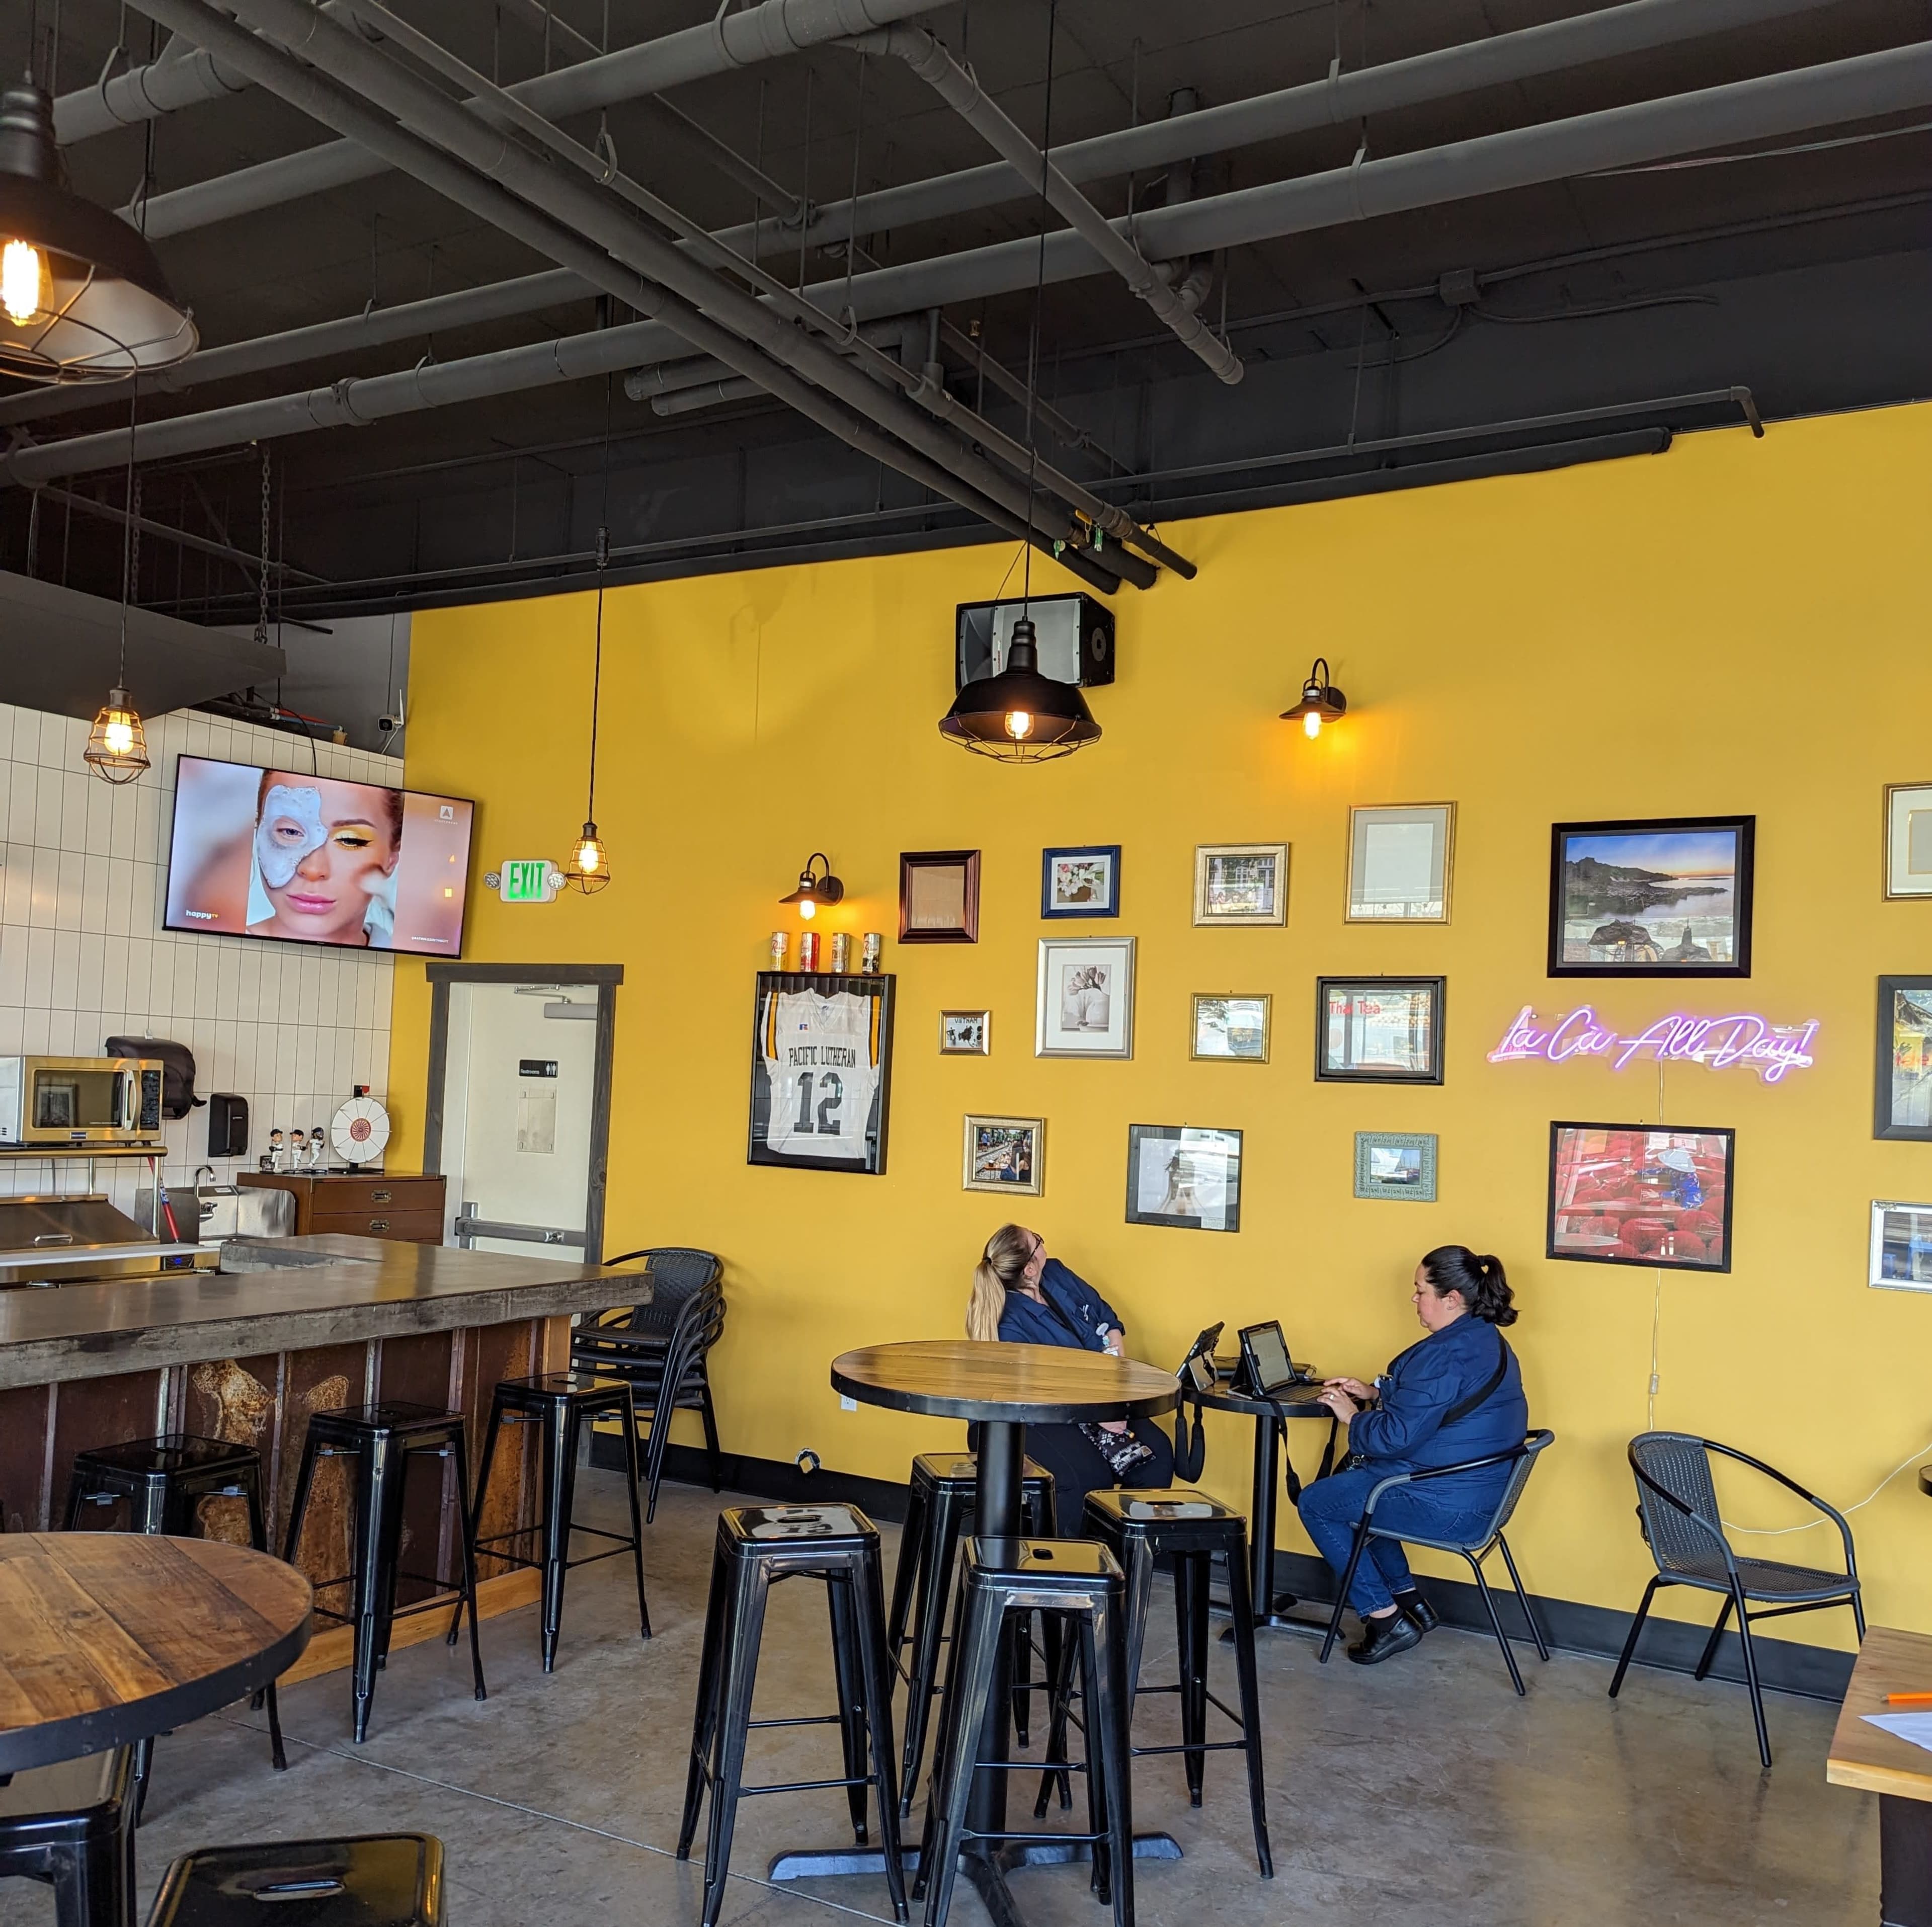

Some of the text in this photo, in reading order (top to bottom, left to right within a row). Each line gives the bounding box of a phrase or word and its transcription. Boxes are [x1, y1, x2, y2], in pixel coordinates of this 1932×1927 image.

[508, 862, 545, 899] EXIT
[1357, 1000, 1380, 1014] Tea
[789, 1046, 856, 1068] PACIFIC LUTHERAN
[1615, 1015, 1712, 1069] All
[1710, 1015, 1817, 1082] Day!
[793, 1072, 843, 1136] 12
